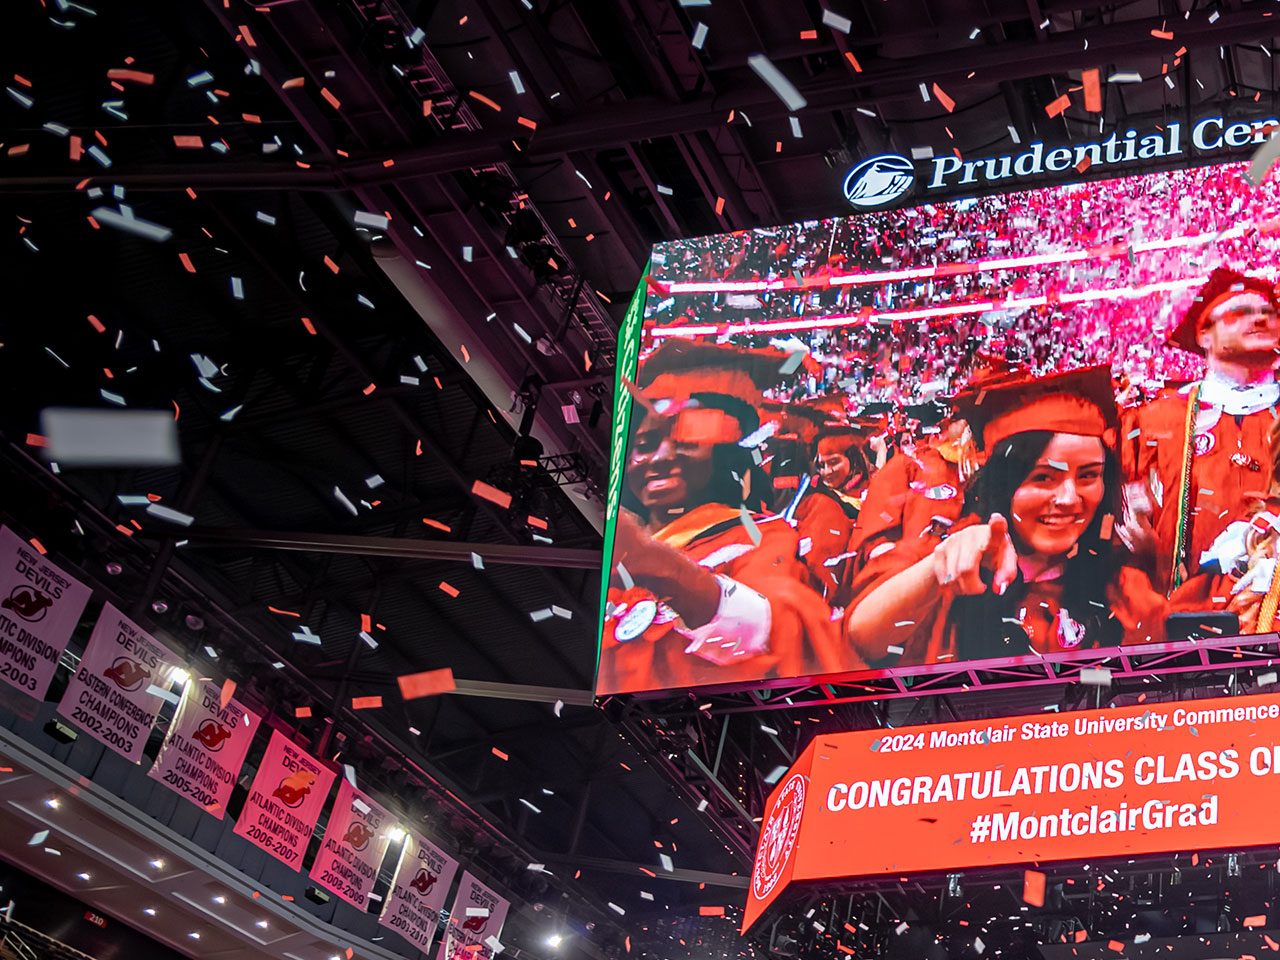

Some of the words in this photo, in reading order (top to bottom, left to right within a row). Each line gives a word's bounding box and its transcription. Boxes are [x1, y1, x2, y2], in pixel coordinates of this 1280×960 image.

[928, 124, 1182, 190] Prudential
[15, 559, 63, 600] DEVILS
[16, 628, 61, 664] DIVISION
[116, 630, 159, 669] DEVILS
[77, 667, 111, 700] EASTERN
[71, 706, 133, 753] 2002-2003
[79, 690, 140, 740] CHAMPIONS
[202, 695, 238, 729] DEVILS
[168, 733, 206, 766] ATLANTIC
[880, 732, 925, 753] 2024
[929, 724, 1017, 750] Montclair
[1020, 720, 1070, 741] State
[1074, 711, 1169, 735] University
[175, 757, 218, 796] CHAMPIONS
[827, 759, 1125, 812] CONGRATULATIONS
[1134, 749, 1241, 786] CLASS
[250, 791, 285, 821] ATLANTIC
[970, 795, 1218, 844] #MontclairGrad
[246, 824, 299, 863] 2006-2007
[258, 813, 299, 848] CHAMPIONS
